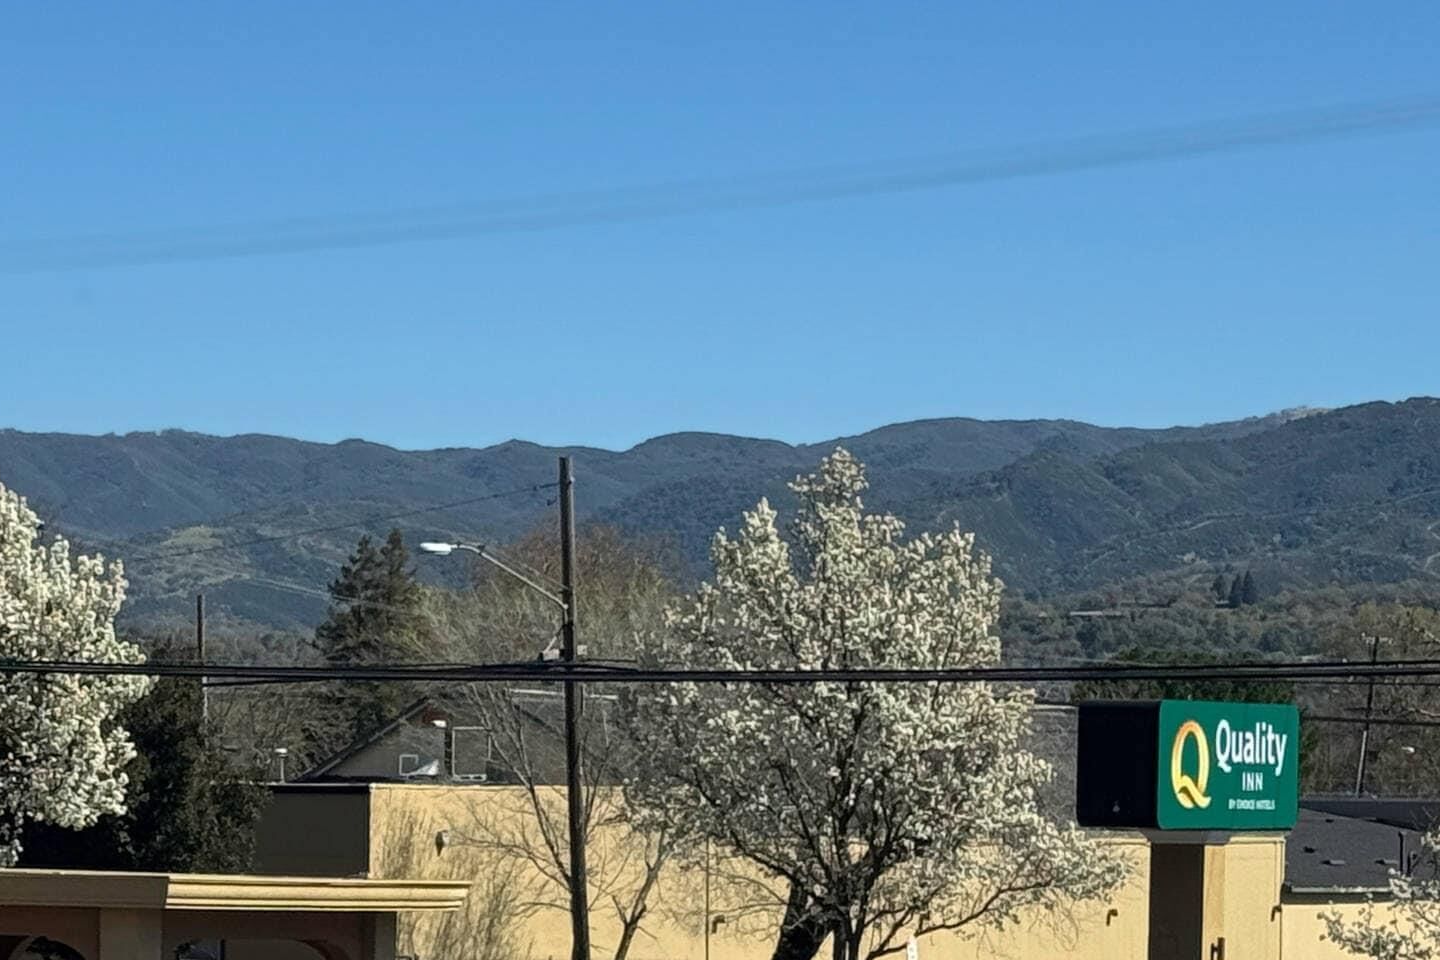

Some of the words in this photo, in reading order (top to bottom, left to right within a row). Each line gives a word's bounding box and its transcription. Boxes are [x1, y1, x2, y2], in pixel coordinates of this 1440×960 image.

[1171, 720, 1212, 809] Q
[1215, 719, 1288, 776] Quality
[1242, 772, 1264, 791] INN
